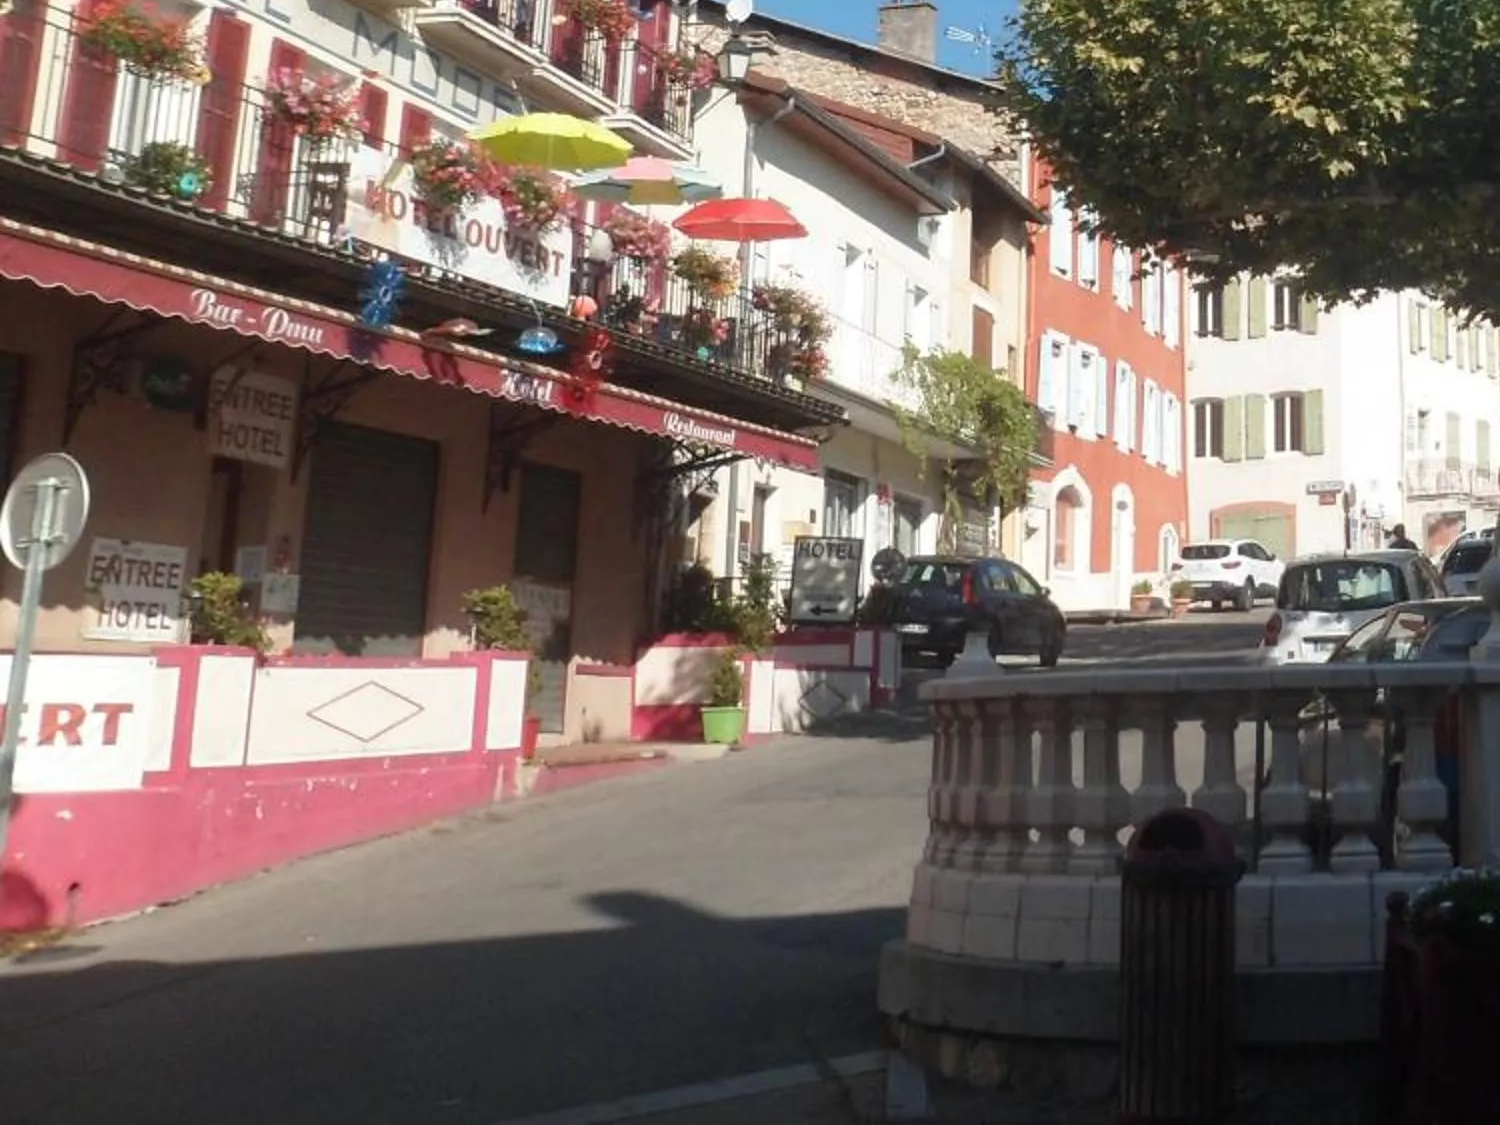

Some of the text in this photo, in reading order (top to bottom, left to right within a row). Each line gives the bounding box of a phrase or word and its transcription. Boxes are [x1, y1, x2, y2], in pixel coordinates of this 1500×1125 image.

[465, 219, 565, 279] OUVERT
[191, 288, 243, 324] Bar
[211, 378, 293, 421] ENTREE
[500, 369, 554, 404] Hotel
[217, 422, 284, 457] HOTEL
[663, 410, 736, 445] Restaurant
[799, 541, 857, 561] HOTEL
[90, 554, 181, 591] ENTREE
[97, 599, 172, 631] HOTEL
